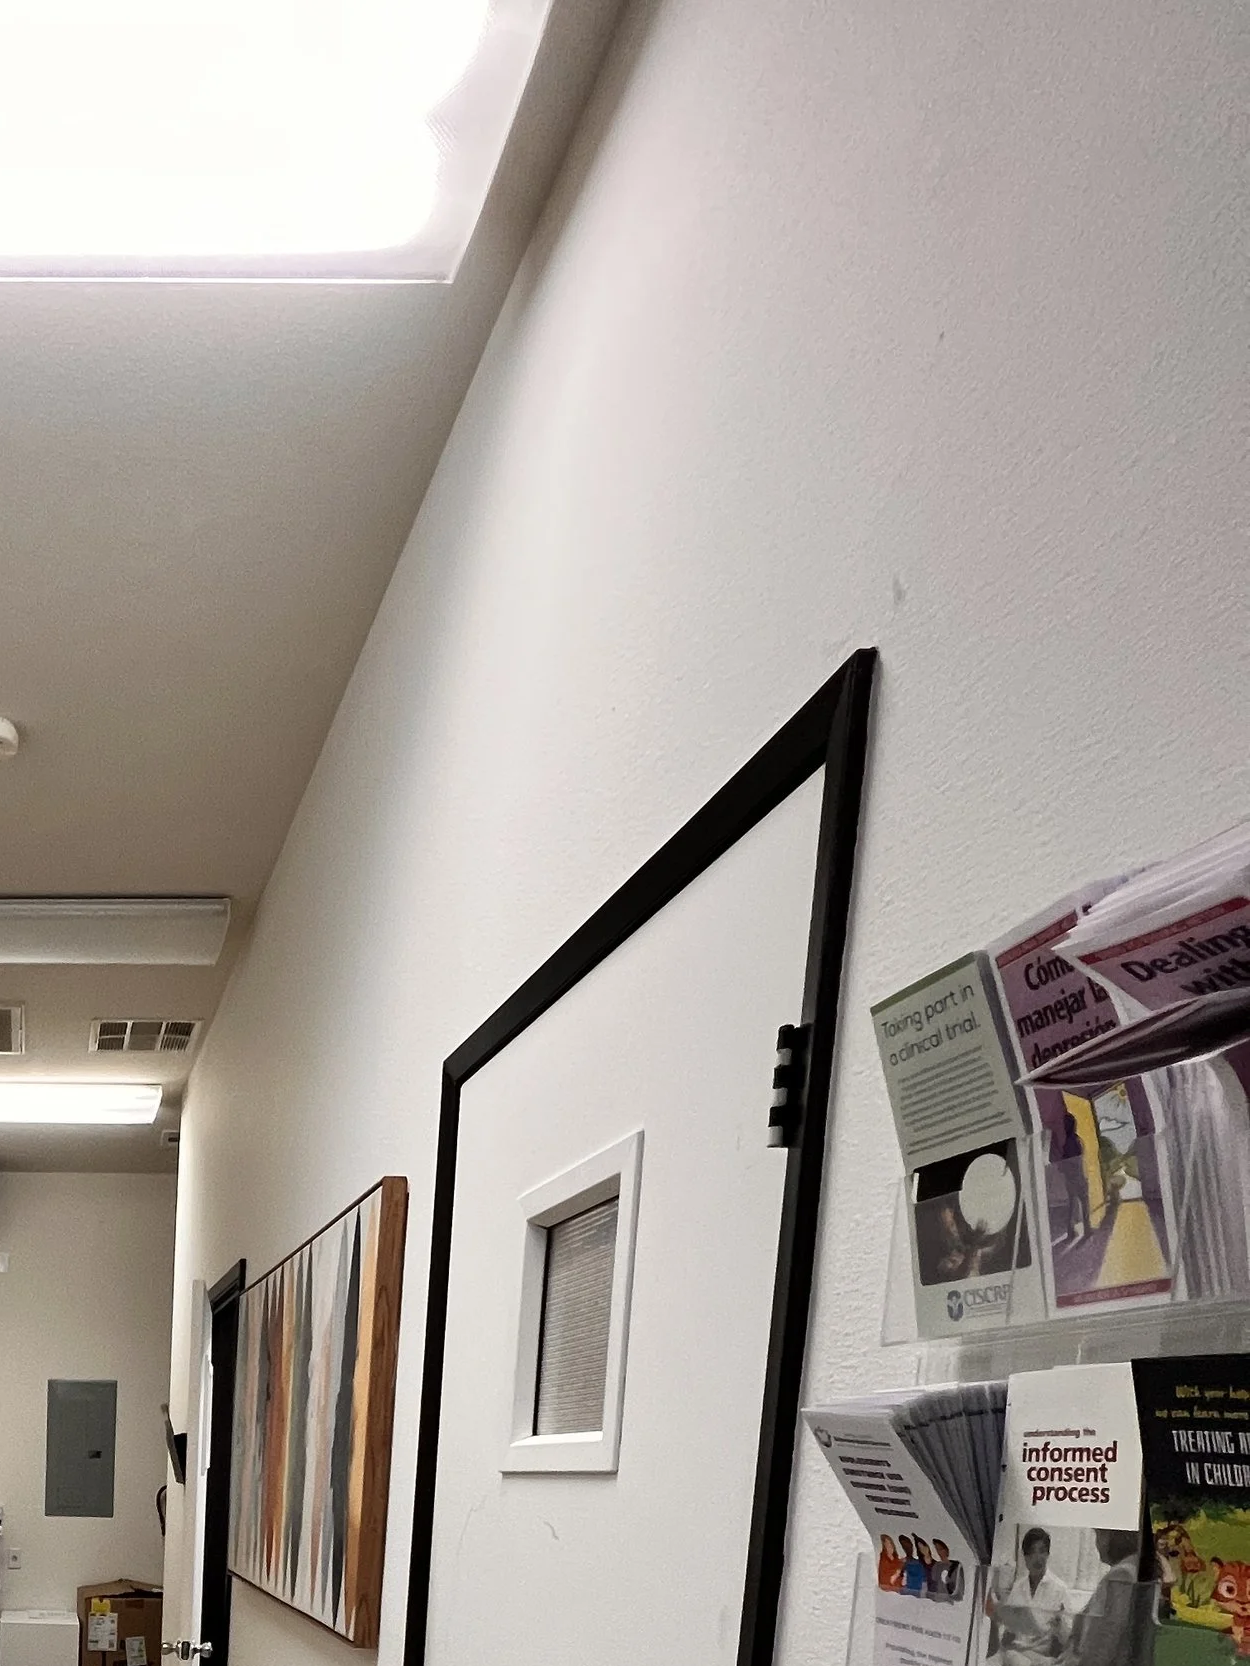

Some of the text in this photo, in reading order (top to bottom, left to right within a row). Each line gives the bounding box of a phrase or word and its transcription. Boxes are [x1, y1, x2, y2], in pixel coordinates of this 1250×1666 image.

[1087, 976, 1111, 1003] la
[881, 984, 975, 1039] Taking part in
[1016, 985, 1086, 1038] manejar
[889, 1011, 981, 1067] a clinical trial.
[1022, 1440, 1118, 1463] informed
[1172, 1430, 1235, 1454] TREATING
[1027, 1463, 1108, 1483] consent
[1185, 1462, 1201, 1485] IN
[1032, 1486, 1110, 1506] process
